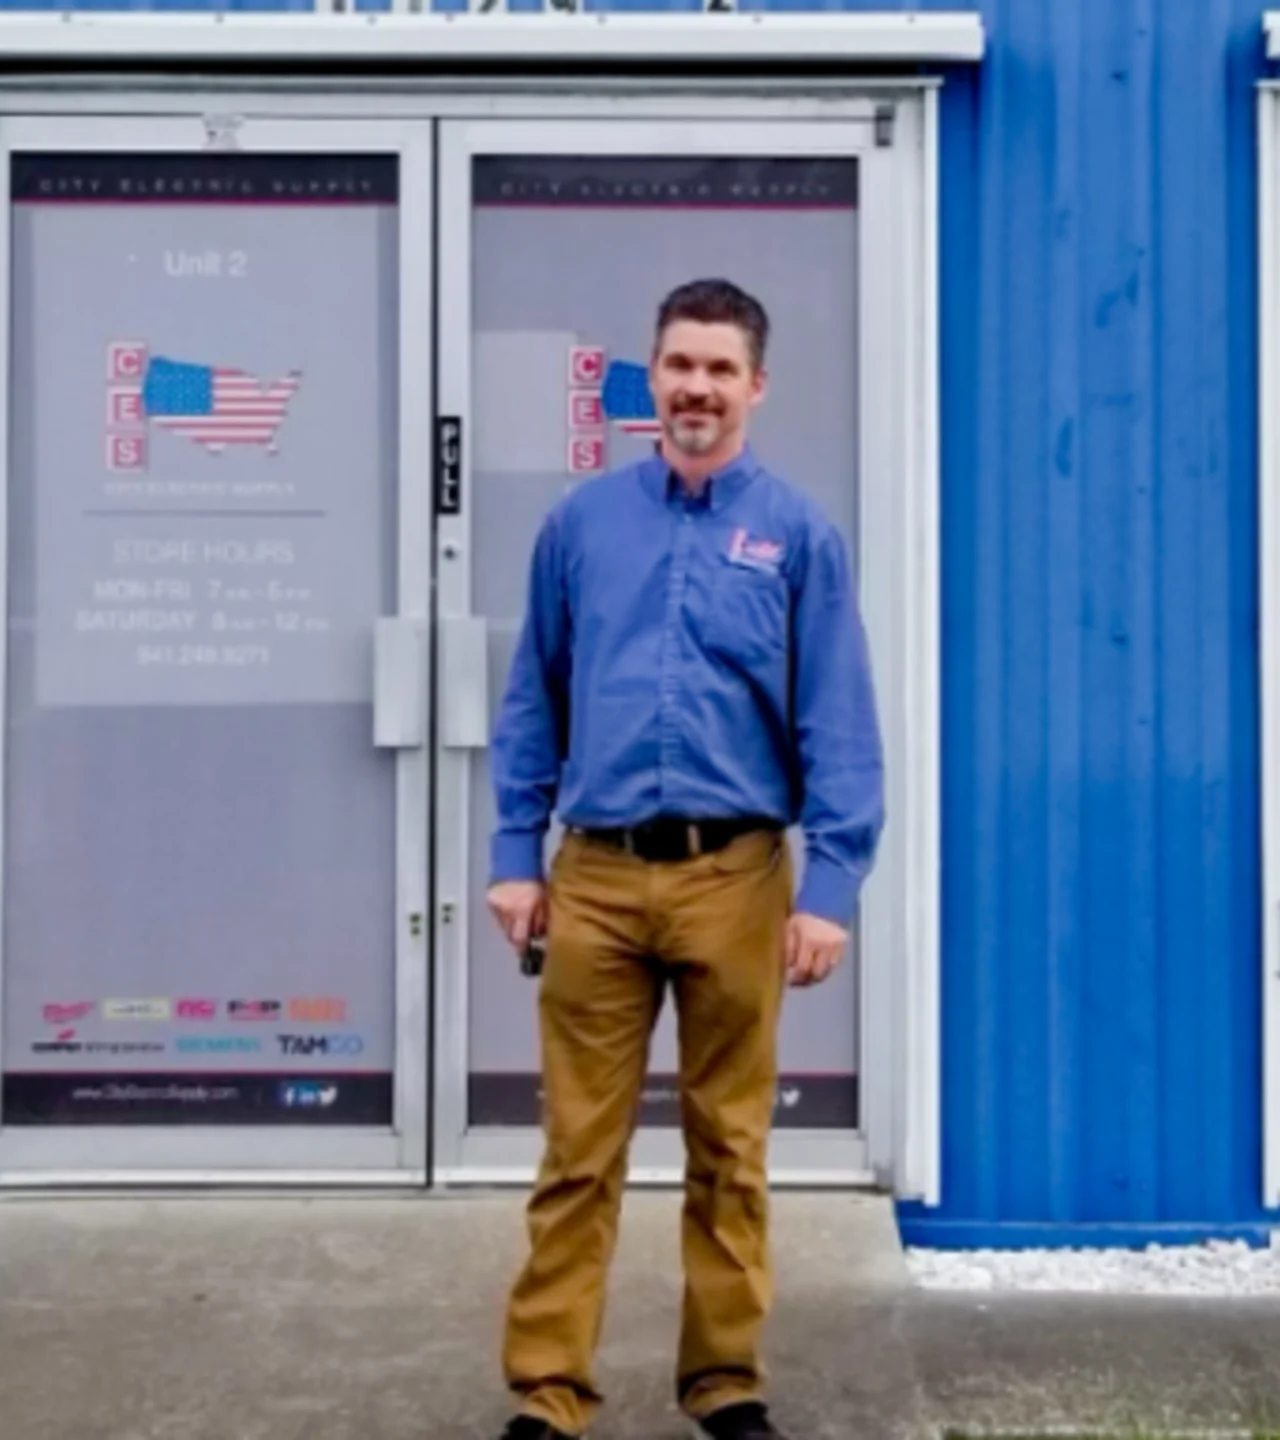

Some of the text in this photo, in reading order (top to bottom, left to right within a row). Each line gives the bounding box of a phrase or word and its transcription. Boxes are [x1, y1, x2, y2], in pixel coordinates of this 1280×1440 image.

[162, 249, 249, 277] Unit 2
[440, 421, 458, 508] PULL
[113, 539, 295, 565] STORE HOURS
[73, 608, 197, 632] SATURDAY
